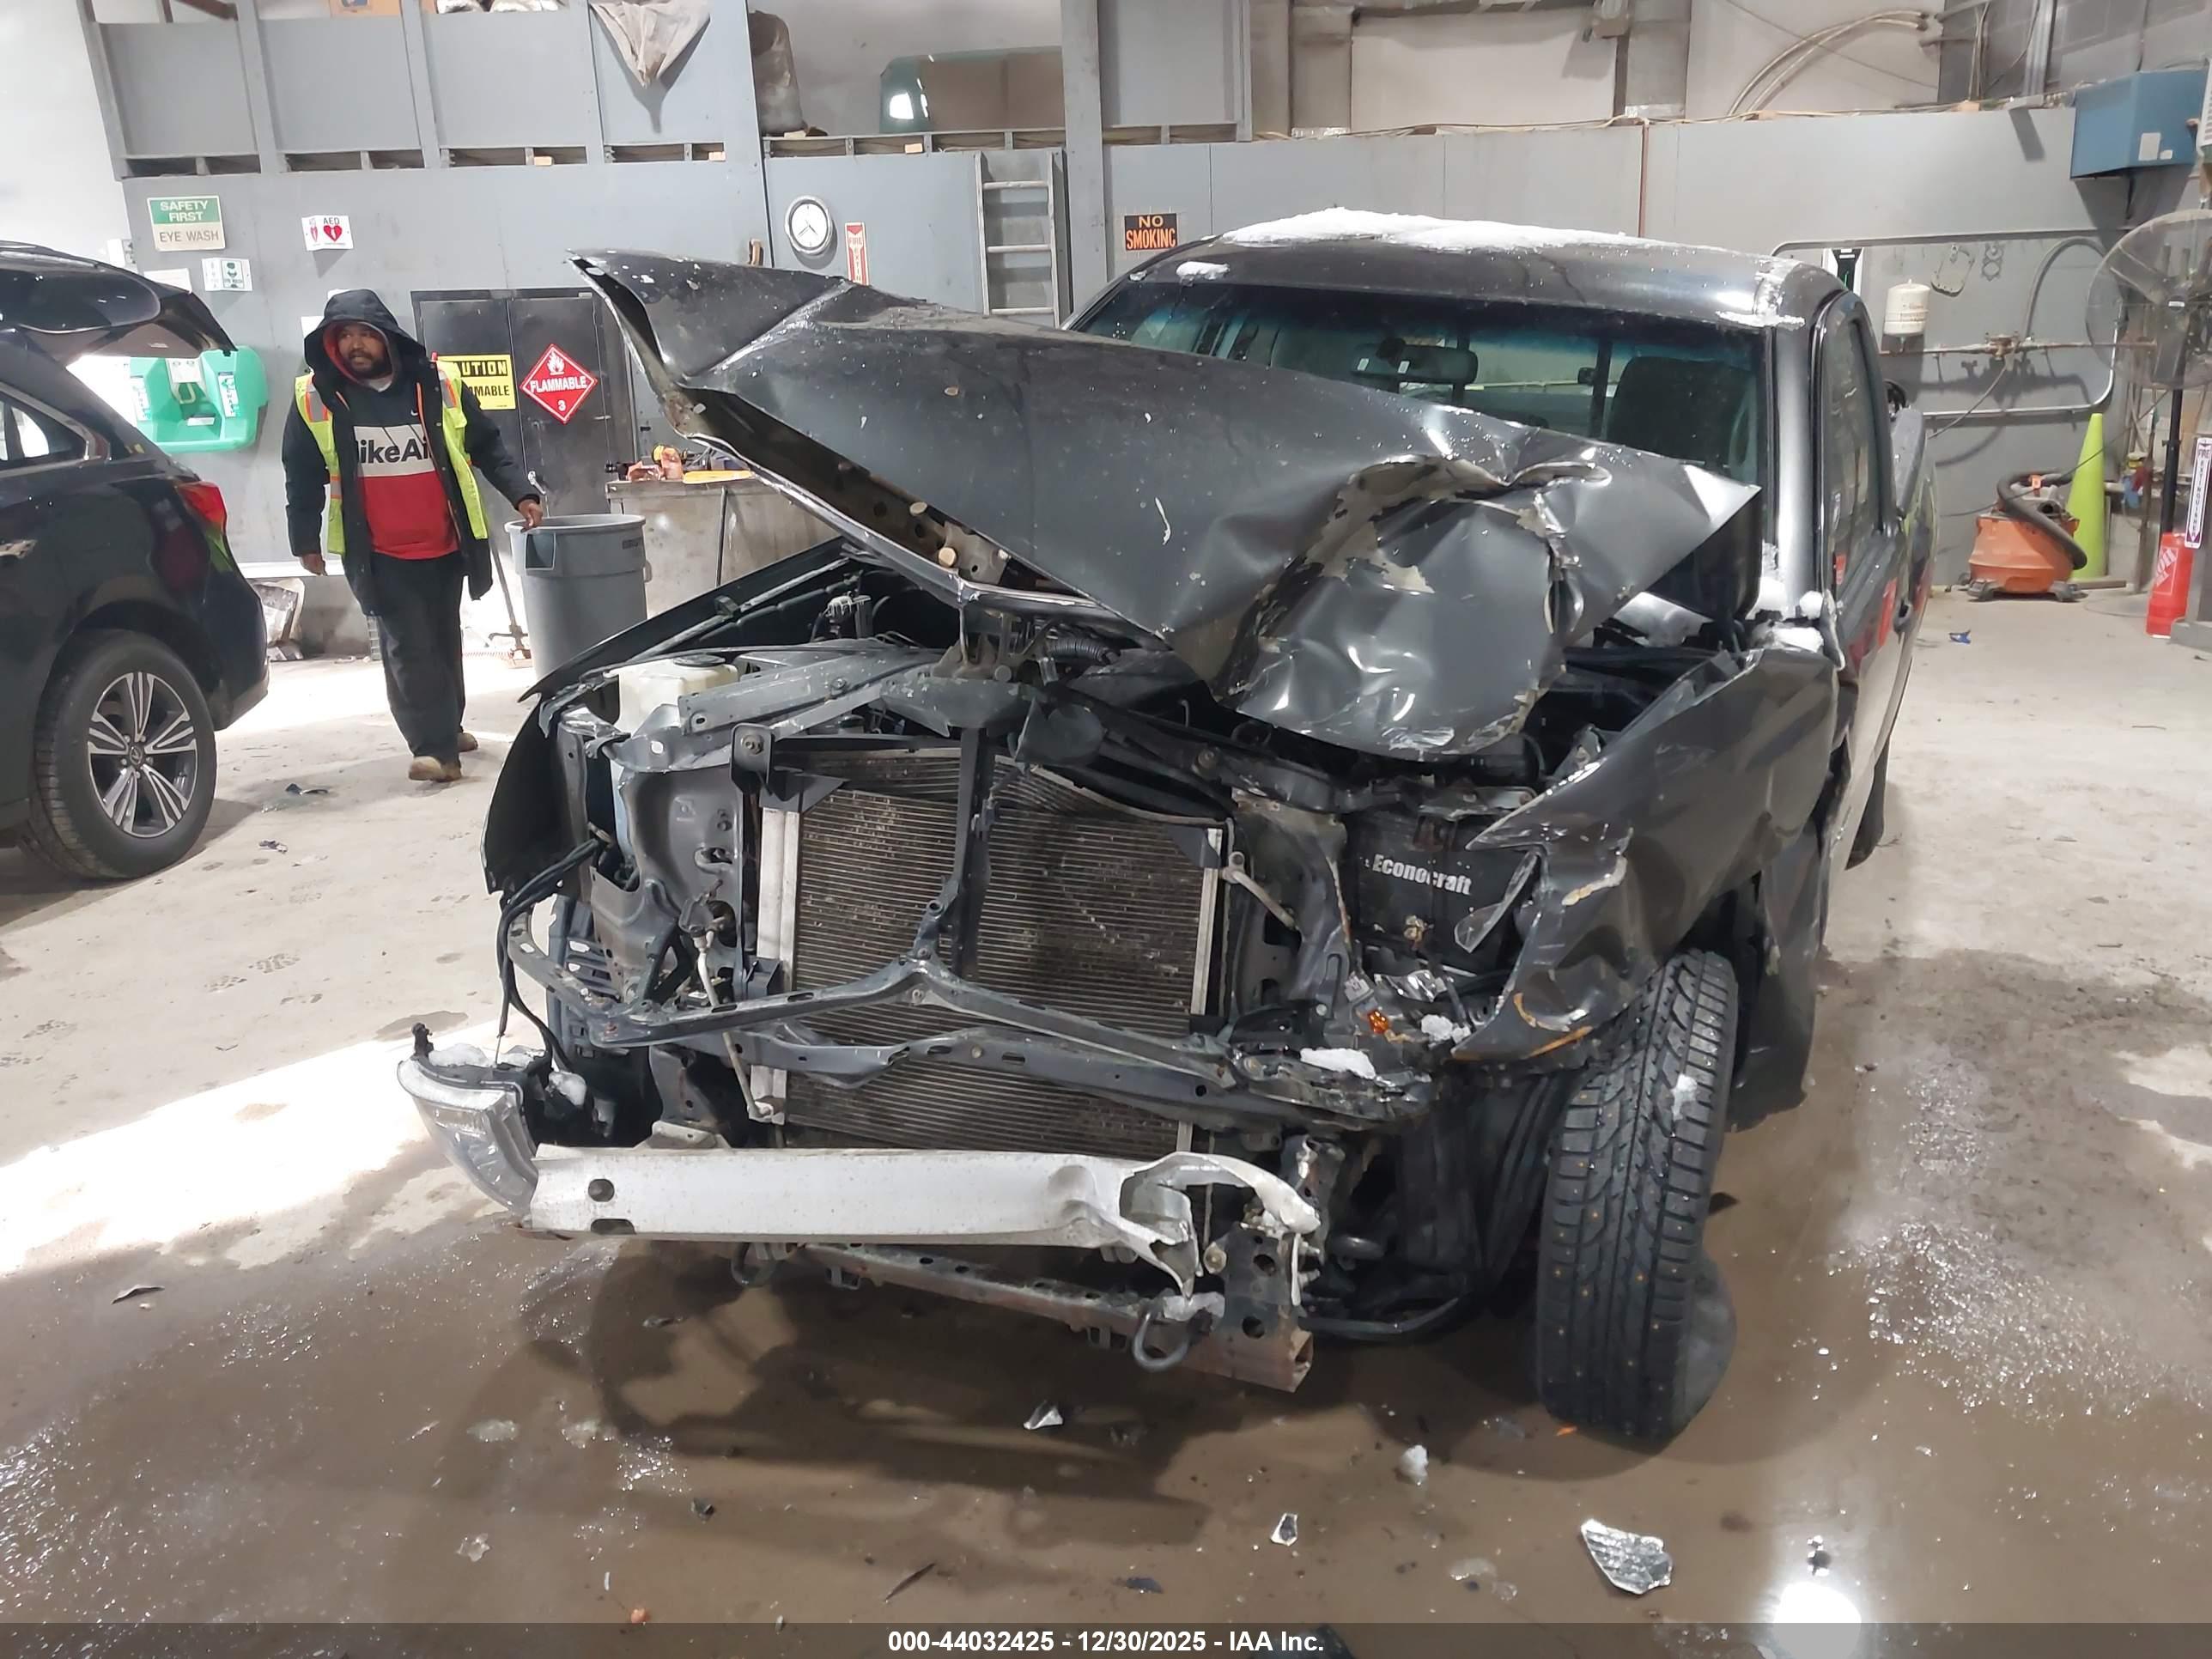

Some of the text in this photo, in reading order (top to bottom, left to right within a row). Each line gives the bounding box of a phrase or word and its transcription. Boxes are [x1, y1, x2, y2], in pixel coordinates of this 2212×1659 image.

[160, 200, 208, 211] SAFETY
[169, 211, 204, 222] FIRST
[324, 216, 340, 225] AED
[1139, 215, 1164, 228] NO
[160, 230, 219, 242] EYE WASH
[455, 361, 507, 376] UTION
[530, 375, 587, 393] FLAMMABLE
[557, 399, 567, 411] 3
[1372, 854, 1472, 896] Econocraft
